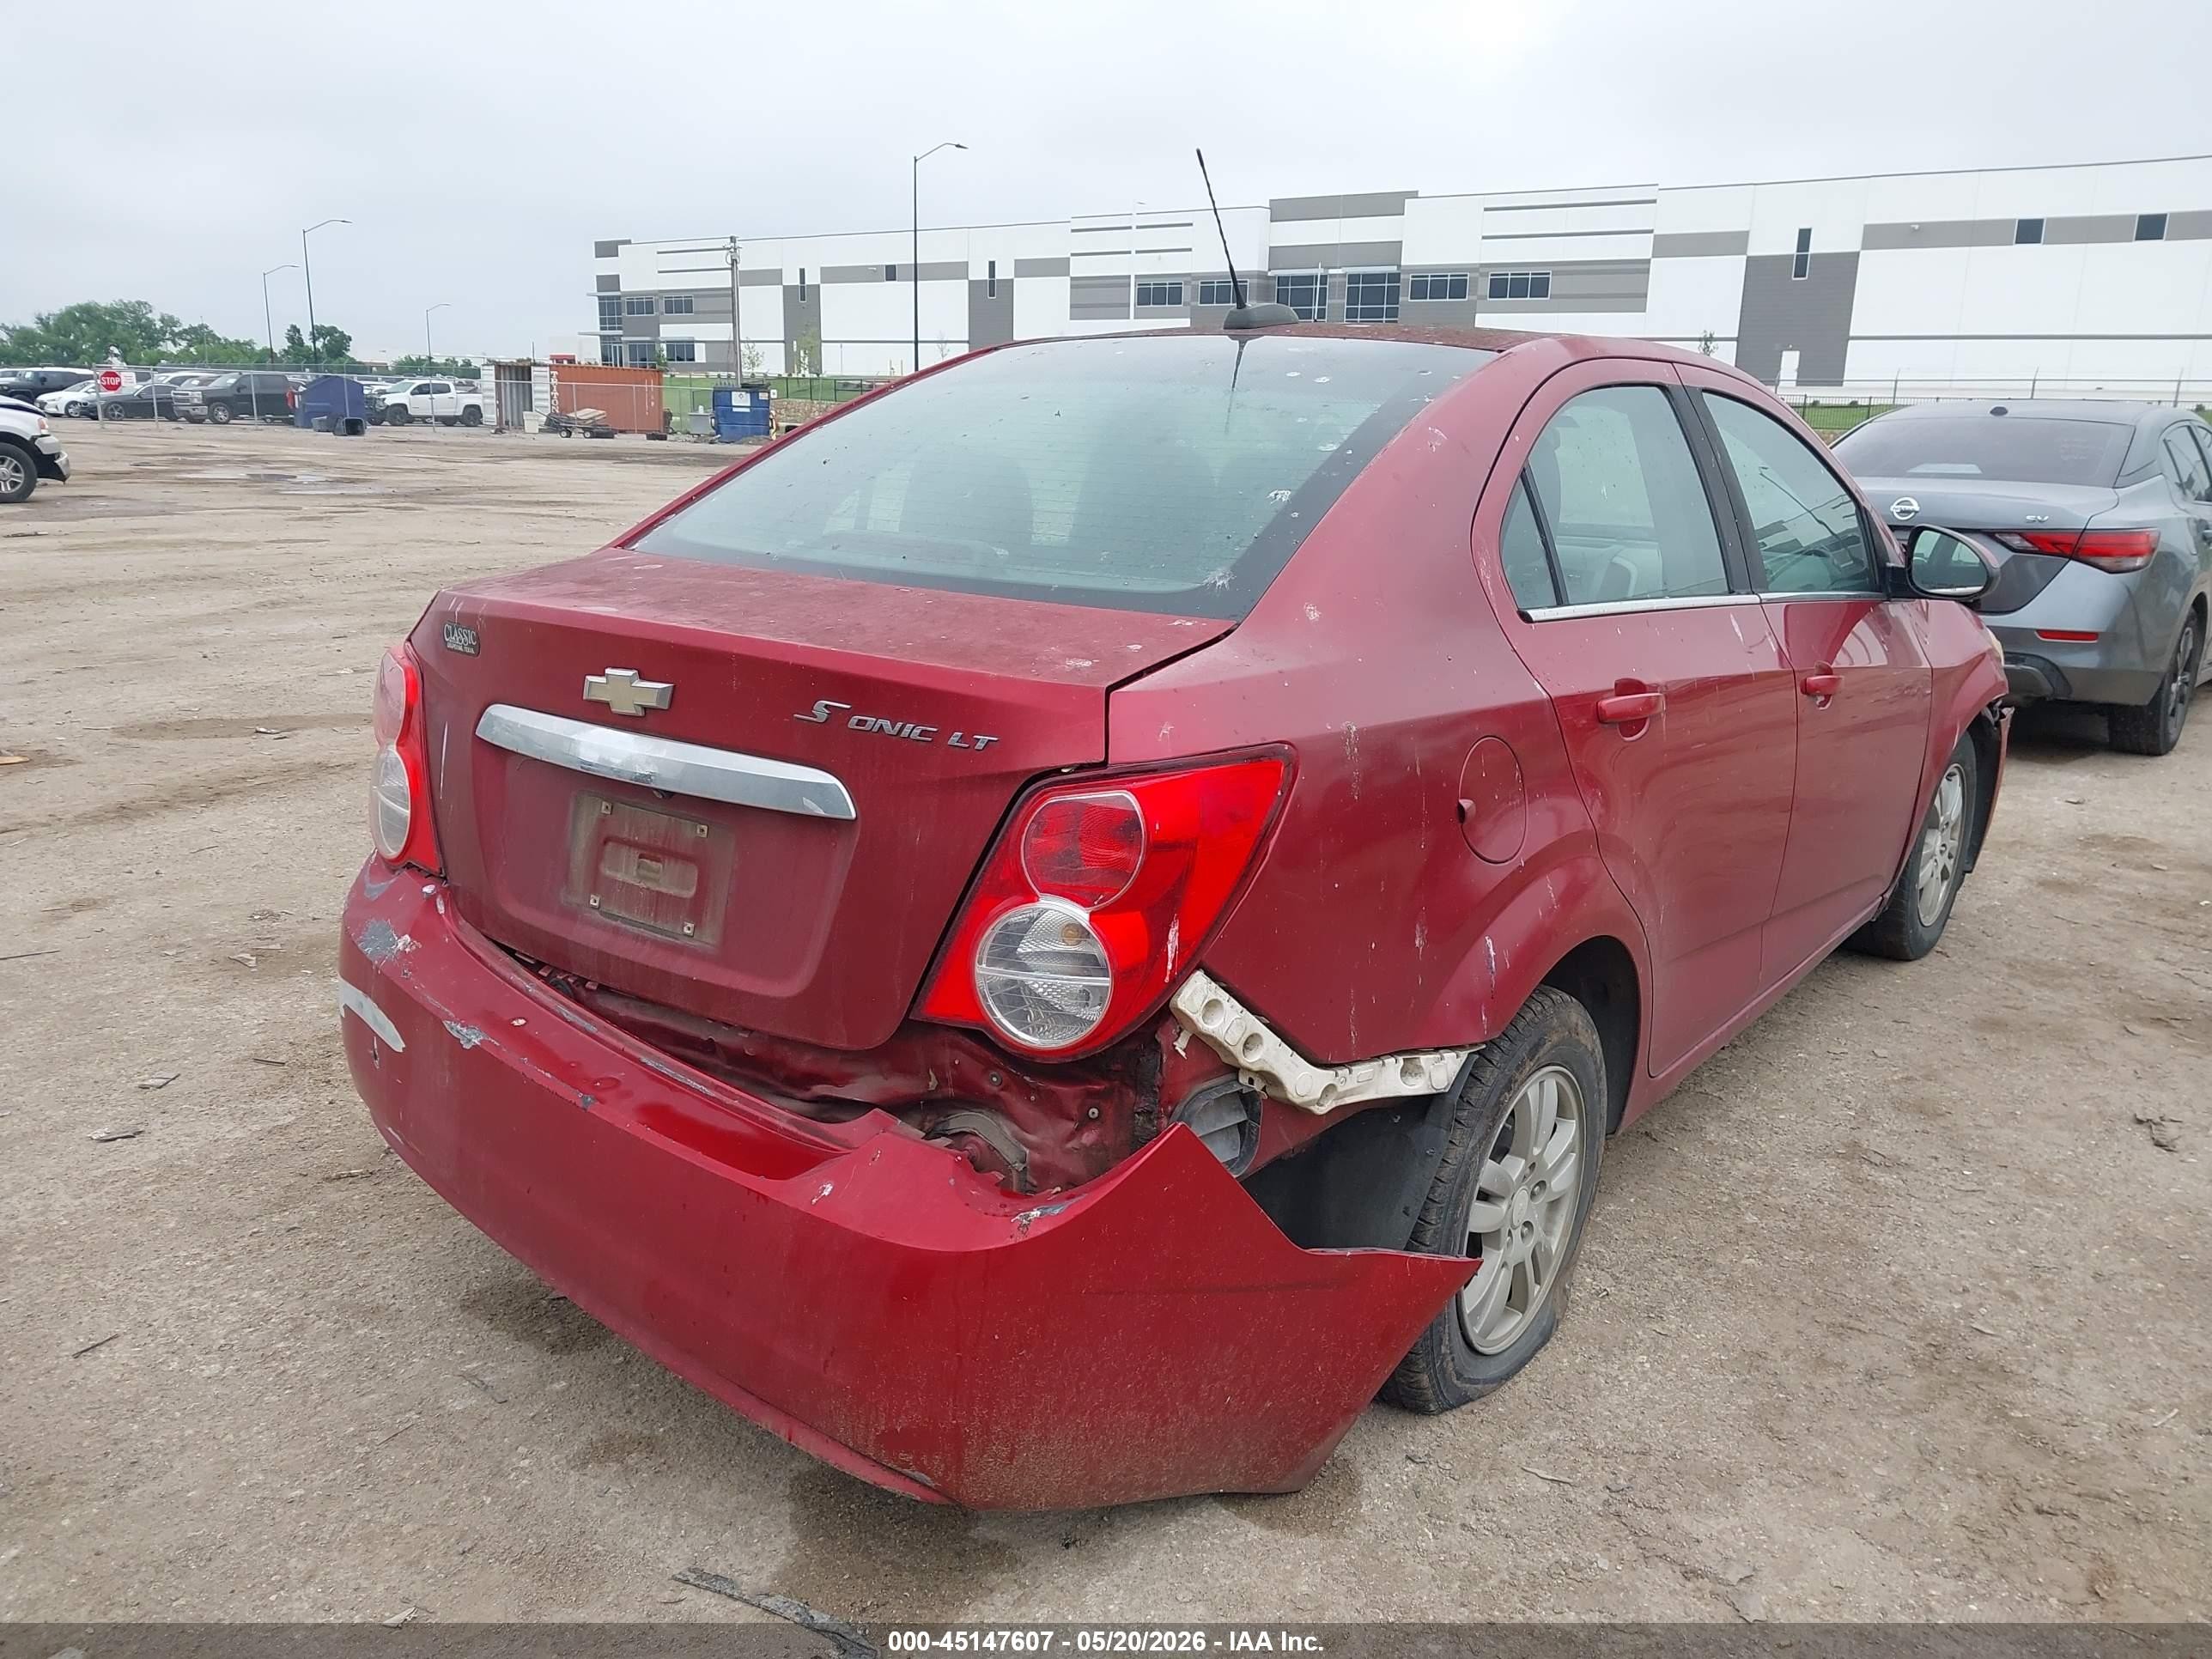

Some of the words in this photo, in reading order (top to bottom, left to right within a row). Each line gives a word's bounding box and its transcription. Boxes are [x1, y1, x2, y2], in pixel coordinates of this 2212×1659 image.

[100, 377, 120, 386] STOP
[550, 370, 559, 413] TRITON
[444, 623, 477, 646] CLASSIC
[947, 732, 999, 750] LT
